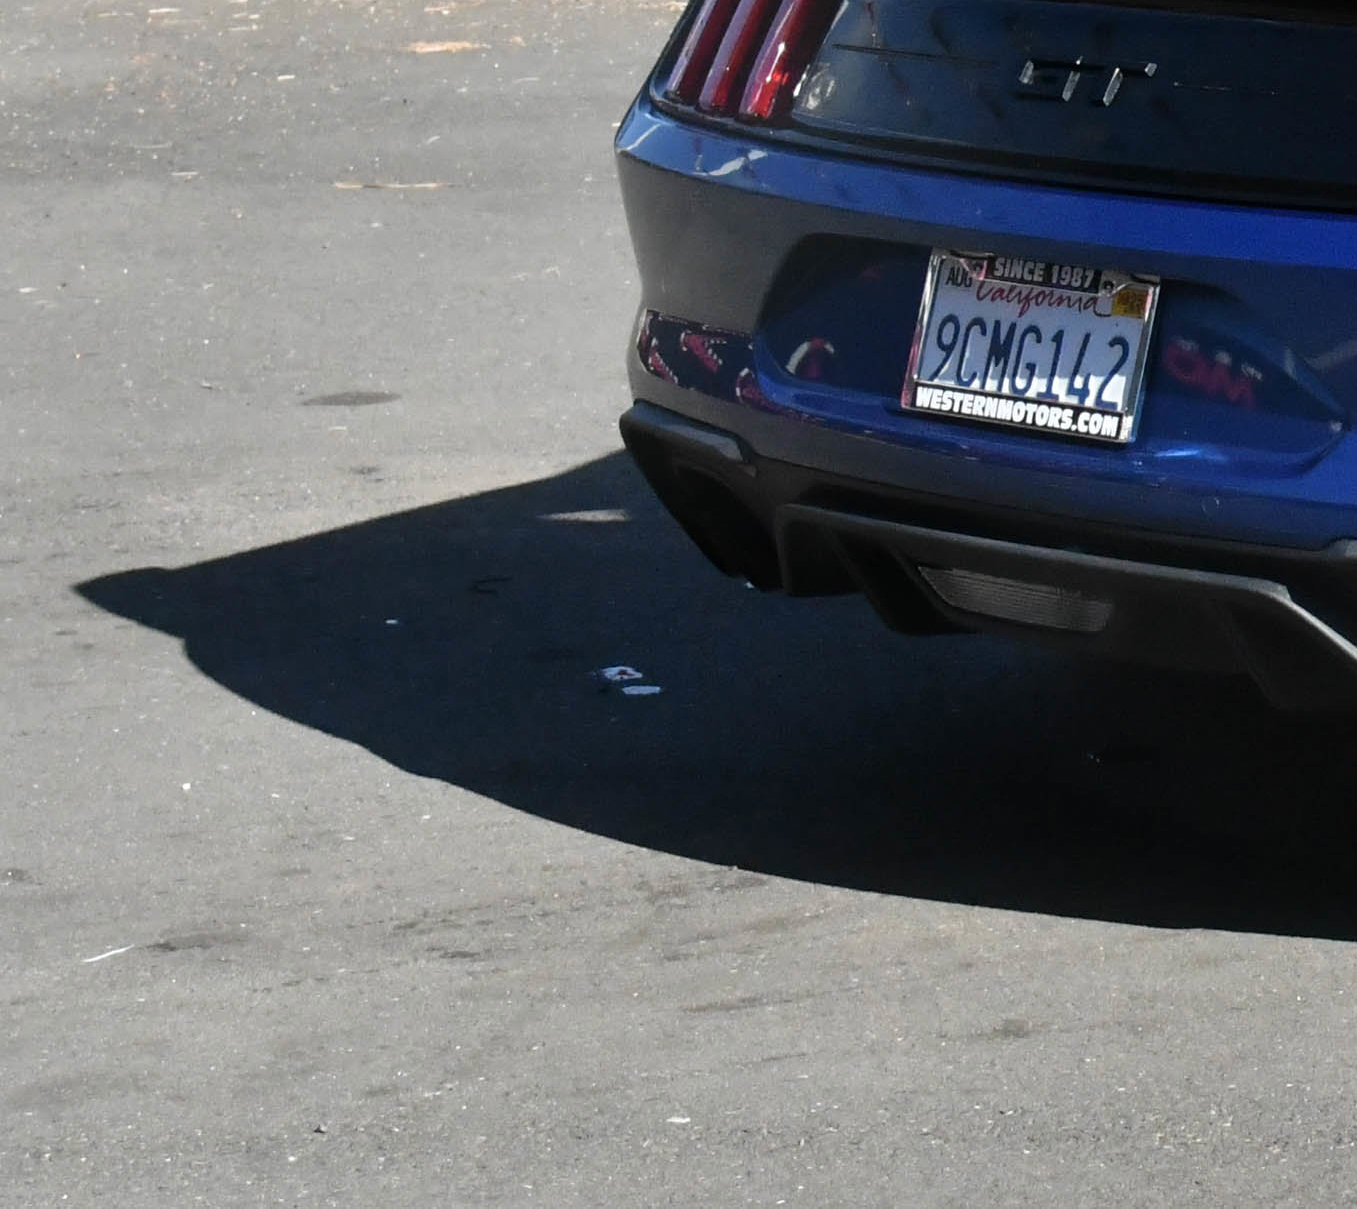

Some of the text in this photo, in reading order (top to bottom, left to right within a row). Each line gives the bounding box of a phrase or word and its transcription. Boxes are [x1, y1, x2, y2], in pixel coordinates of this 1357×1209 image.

[1016, 56, 1158, 107] GT
[994, 257, 1096, 289] SINCE 1987
[926, 313, 1130, 412] 9CMG142
[916, 387, 1119, 438] WESTERNMOTORS.COM
